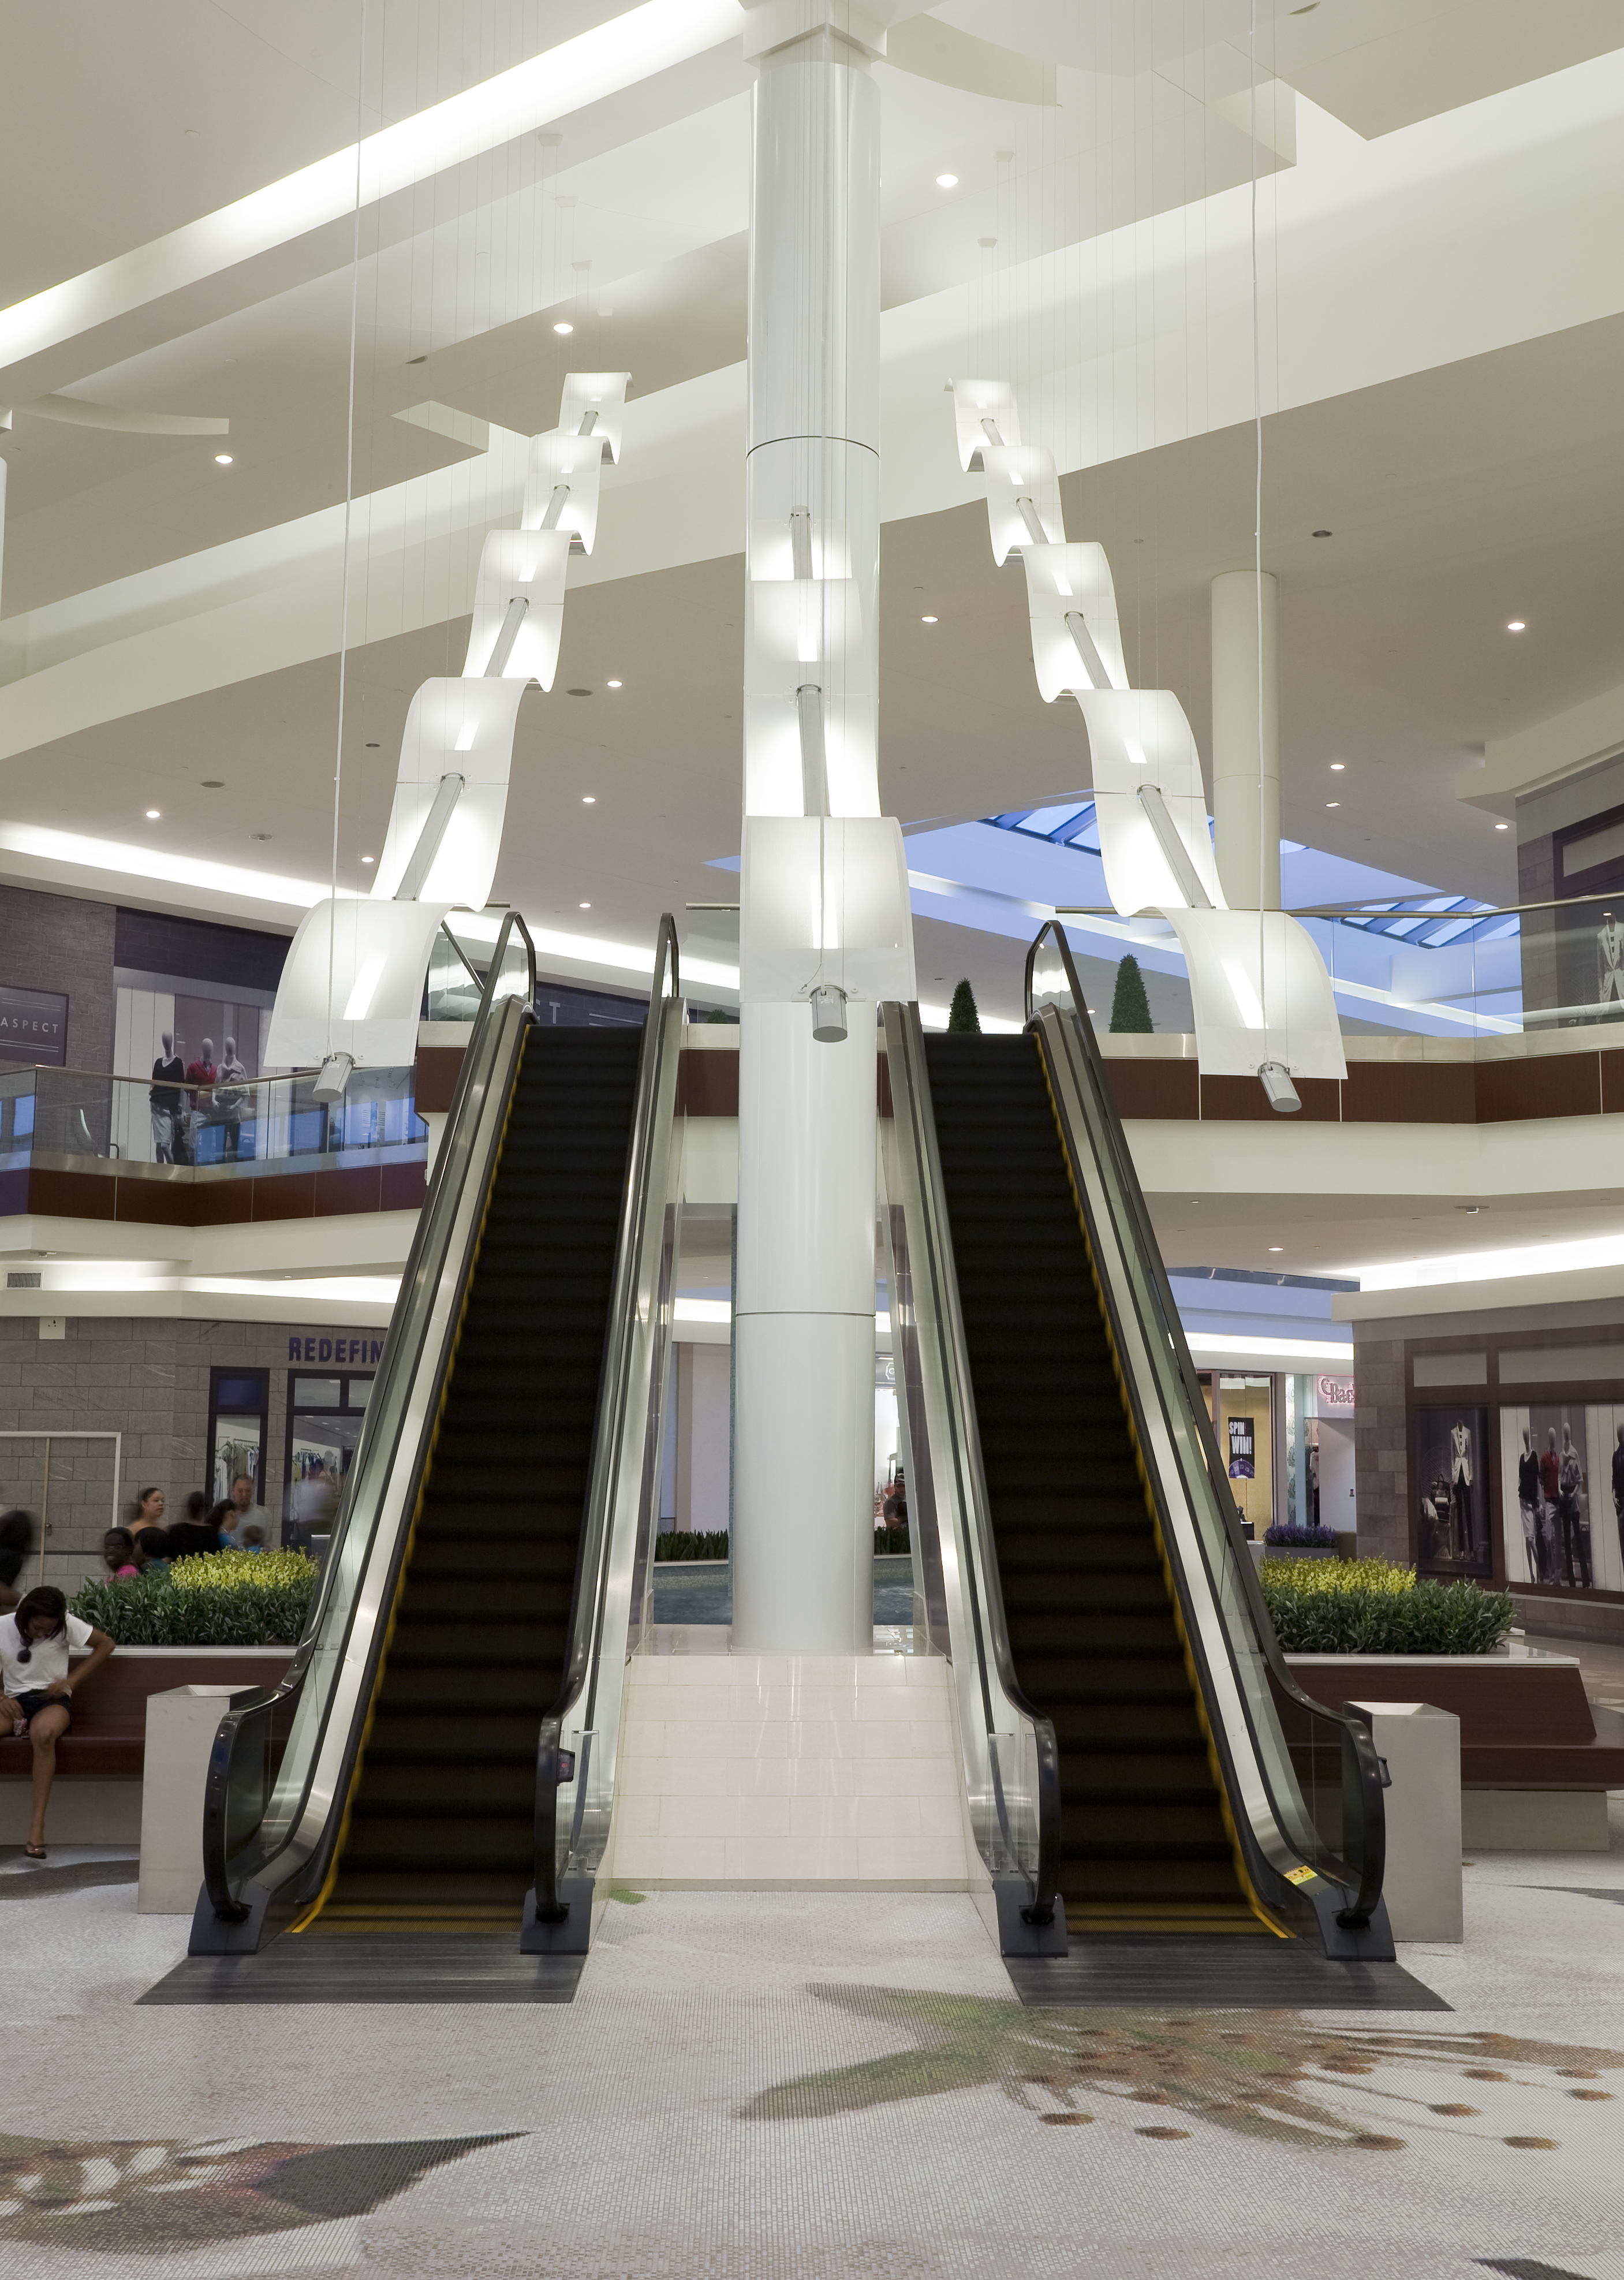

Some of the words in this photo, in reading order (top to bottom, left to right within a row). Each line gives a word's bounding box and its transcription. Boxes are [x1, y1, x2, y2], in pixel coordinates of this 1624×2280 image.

[1, 1017, 58, 1033] ASPECT
[1229, 1421, 1245, 1435] SPIN
[1231, 1435, 1252, 1454] WIN!
